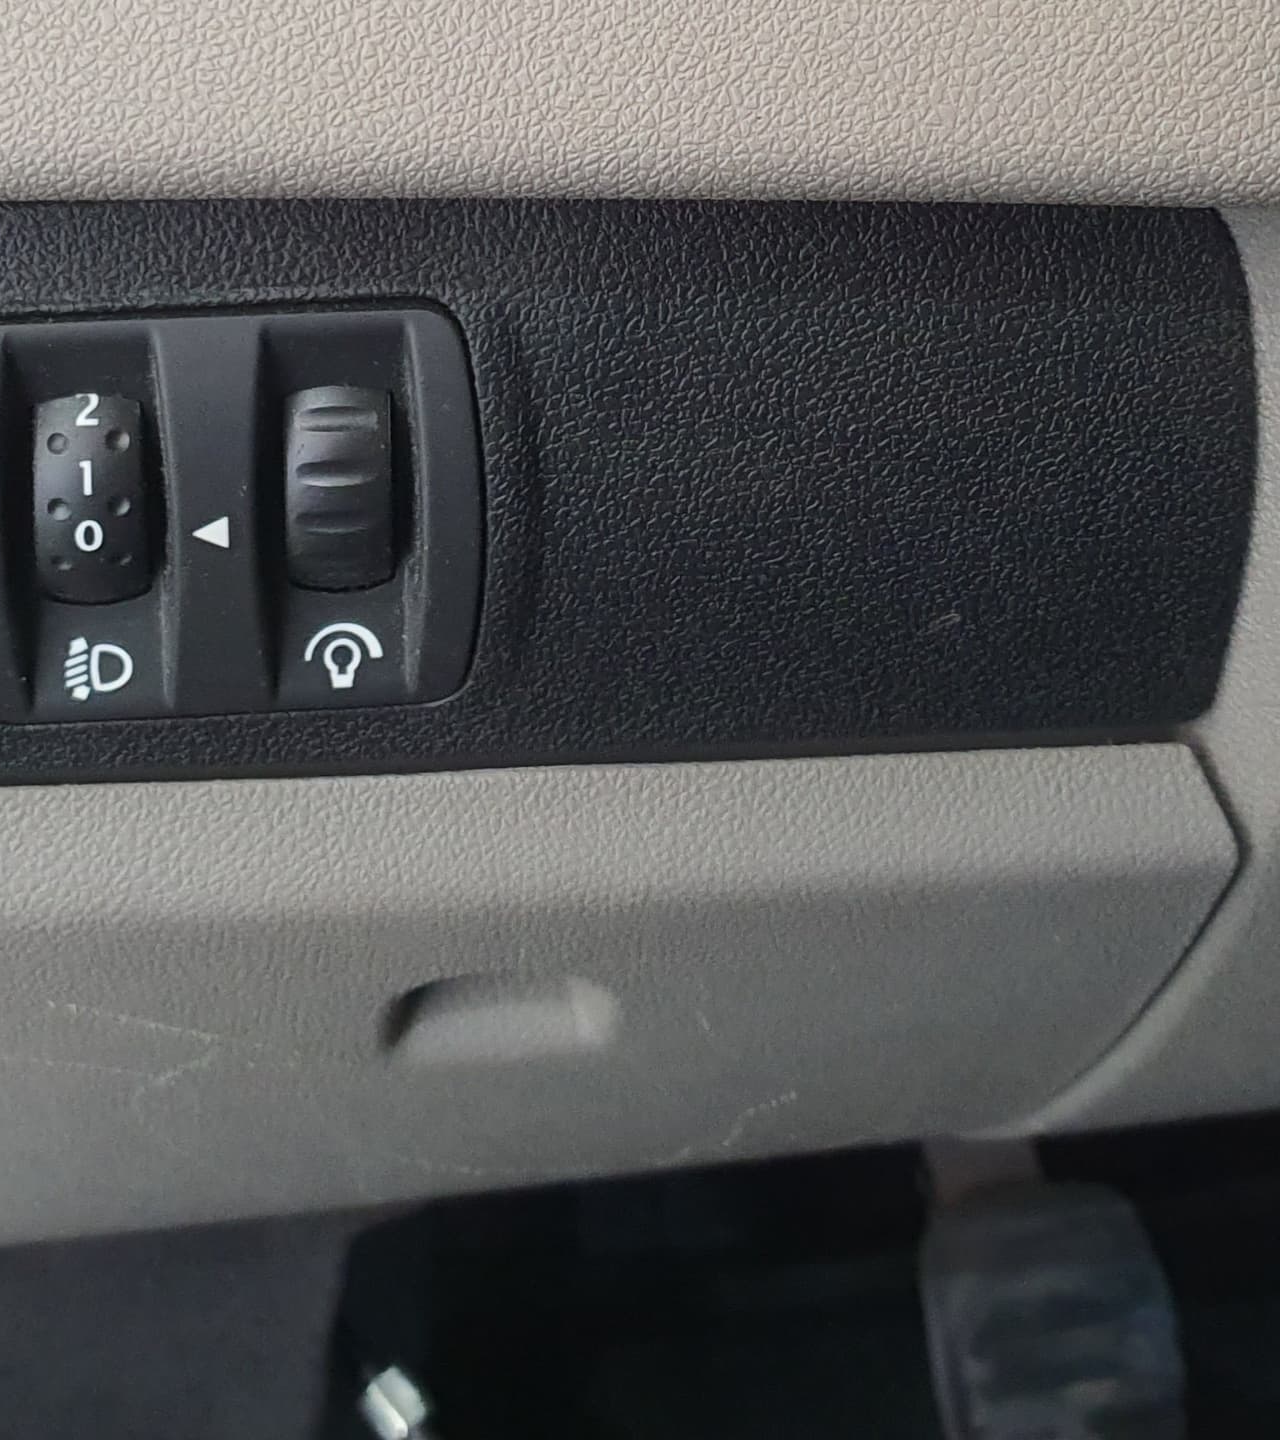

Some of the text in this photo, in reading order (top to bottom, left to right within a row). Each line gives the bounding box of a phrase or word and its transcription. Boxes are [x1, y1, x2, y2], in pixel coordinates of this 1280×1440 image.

[75, 392, 99, 427] 2
[78, 460, 93, 496] 1
[74, 519, 104, 552] 0
